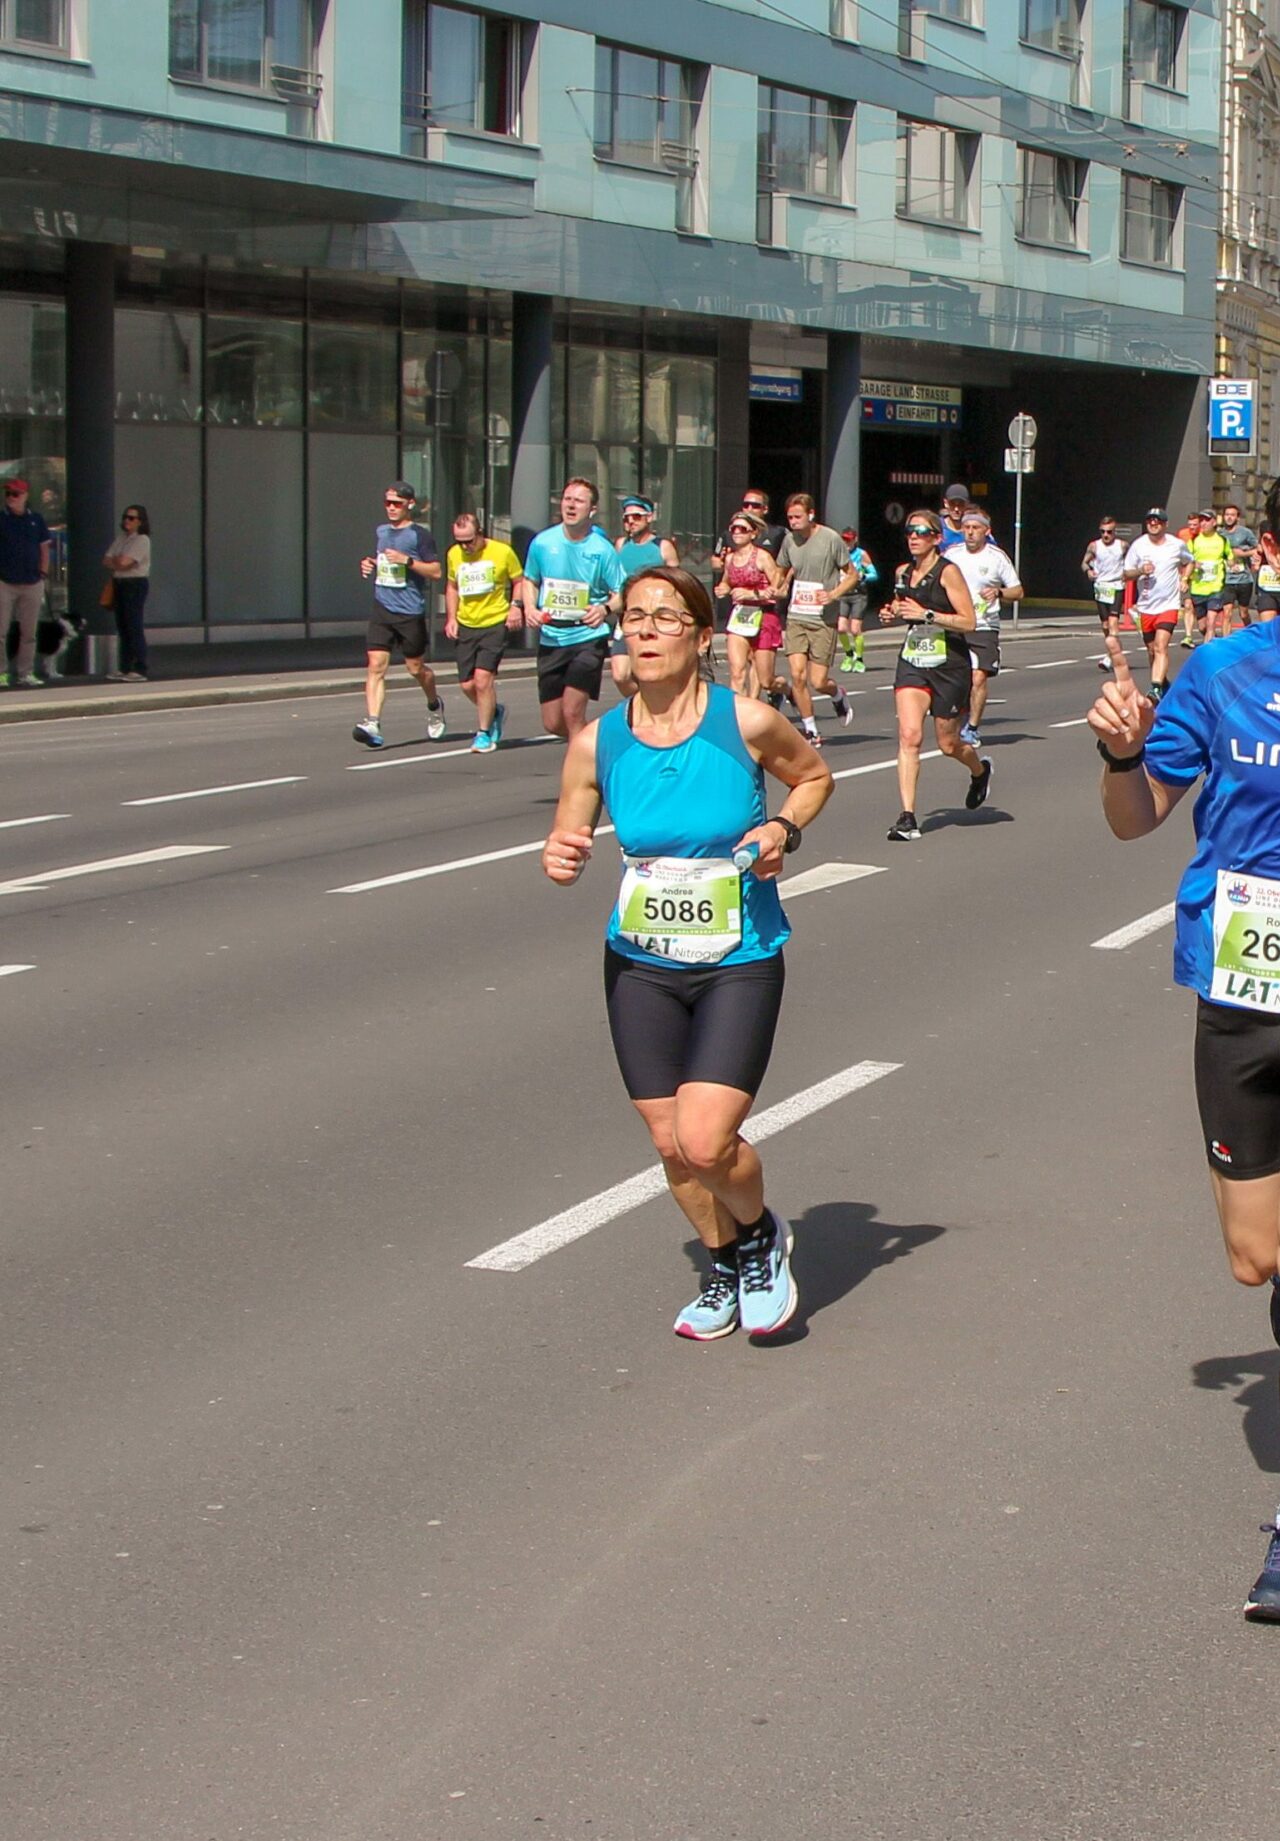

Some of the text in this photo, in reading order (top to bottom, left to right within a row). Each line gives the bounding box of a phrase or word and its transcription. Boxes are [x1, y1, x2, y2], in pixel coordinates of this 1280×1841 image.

[859, 383, 950, 402] GARAGE LANDSTRASSE
[898, 406, 935, 420] EINFAHRT
[1221, 409, 1241, 437] P
[552, 594, 577, 606] 2631
[661, 888, 693, 896] Andrea
[644, 897, 713, 923] 5086
[1225, 973, 1271, 1004] LAT
